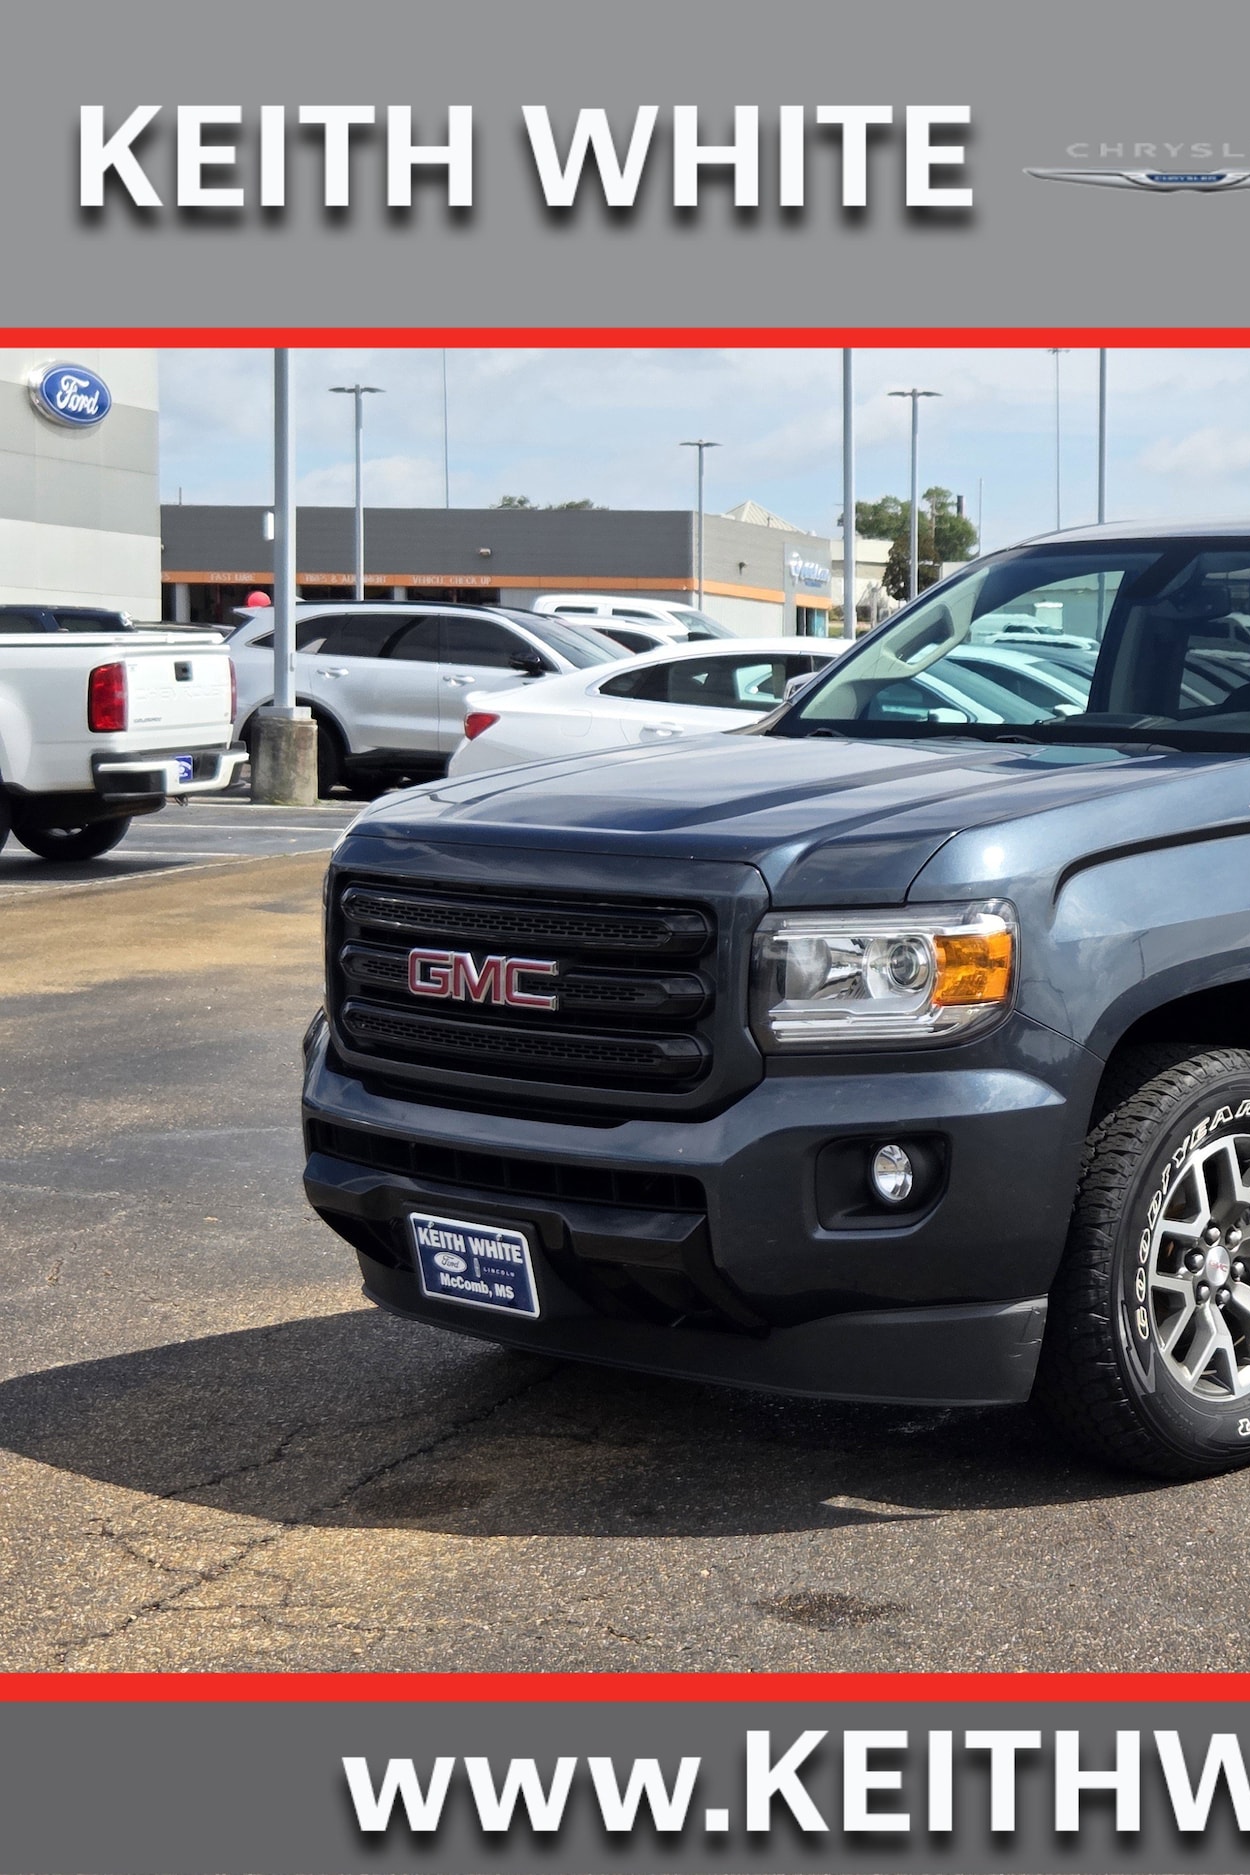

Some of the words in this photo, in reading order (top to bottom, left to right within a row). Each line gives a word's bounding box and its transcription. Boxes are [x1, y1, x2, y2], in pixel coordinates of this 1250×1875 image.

[56, 375, 100, 415] Ford
[408, 948, 559, 1011] GMC
[417, 1226, 466, 1254] KEITH
[468, 1236, 524, 1264] WHITE
[441, 1255, 460, 1269] Ford
[483, 1266, 515, 1278] LINCOLN
[440, 1272, 493, 1298] McComb,
[494, 1283, 515, 1300] MS
